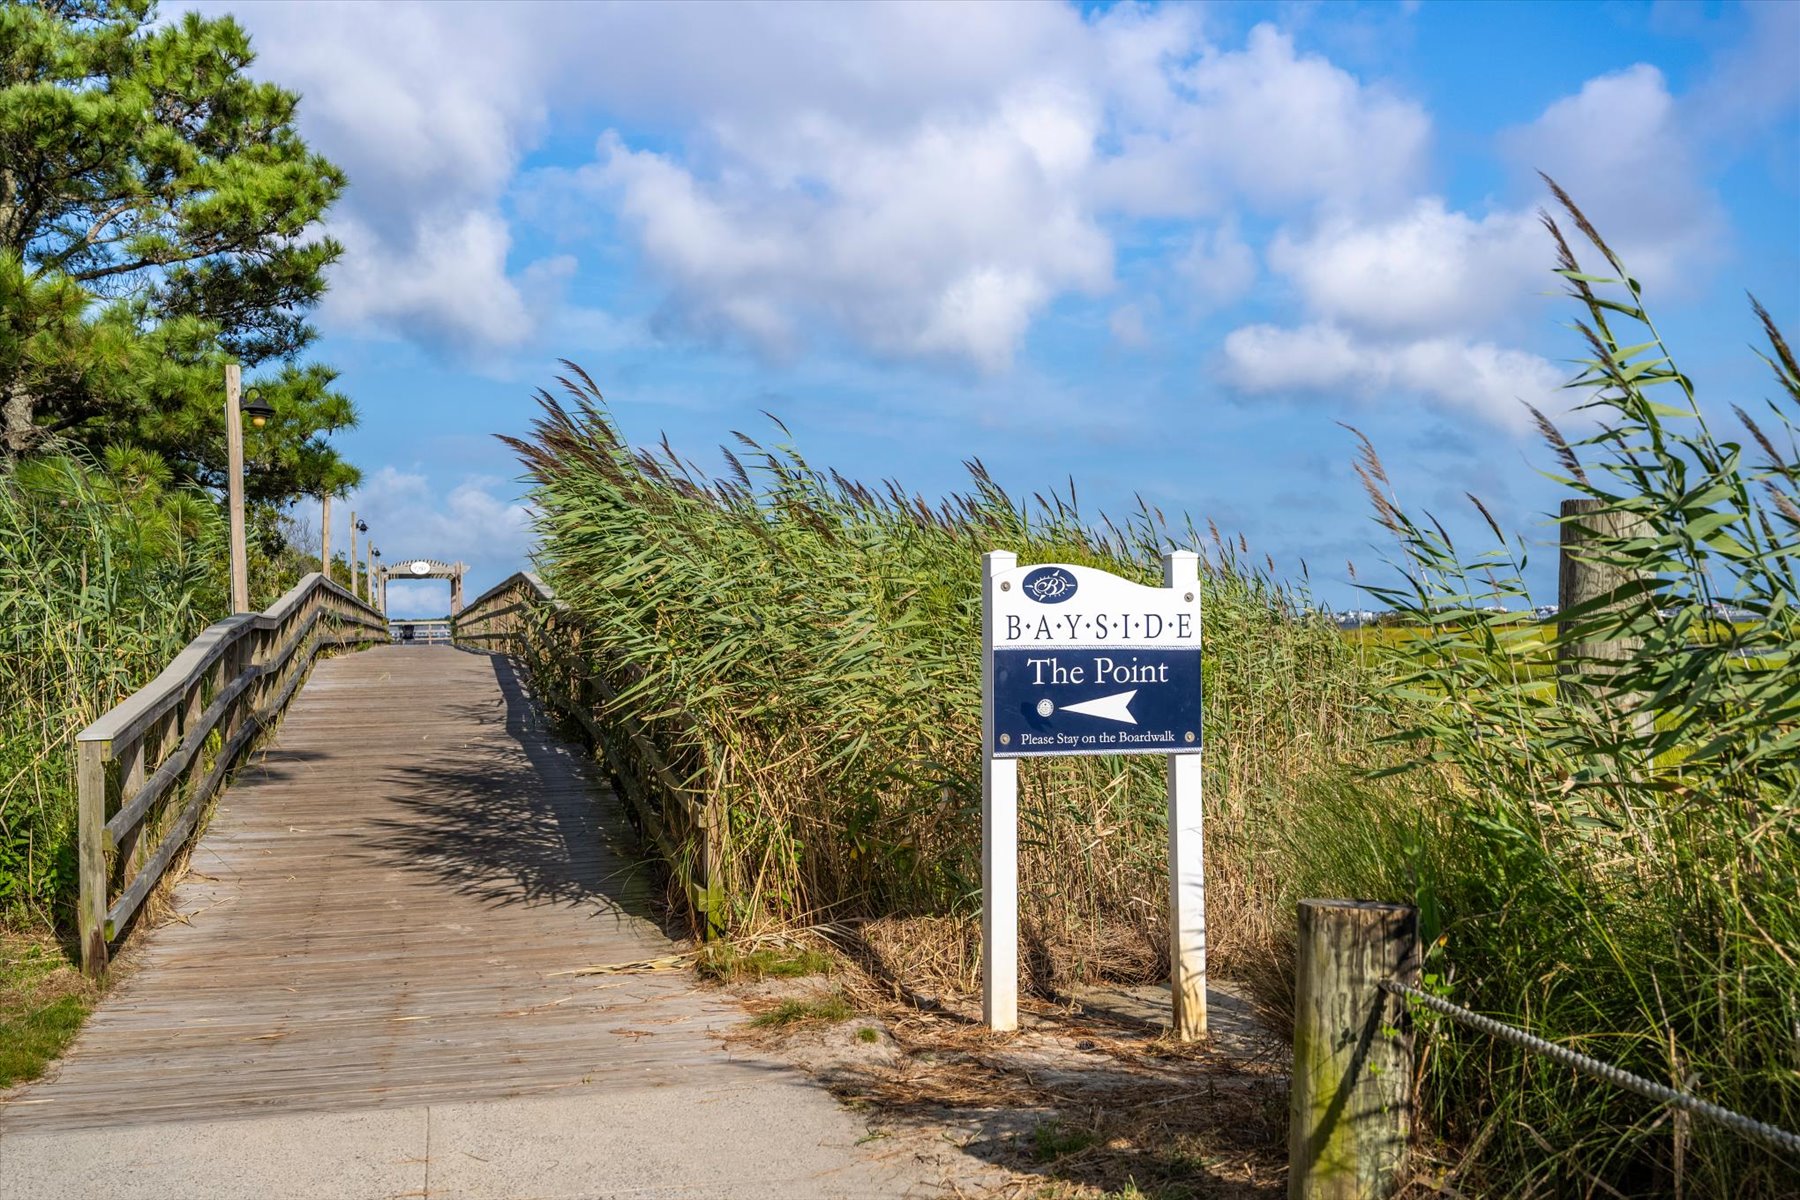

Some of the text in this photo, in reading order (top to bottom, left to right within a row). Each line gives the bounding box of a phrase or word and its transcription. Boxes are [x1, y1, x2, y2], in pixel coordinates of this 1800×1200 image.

[1027, 657, 1169, 685] The Point
[1021, 731, 1175, 747] Please Stay on the Boardwalk
